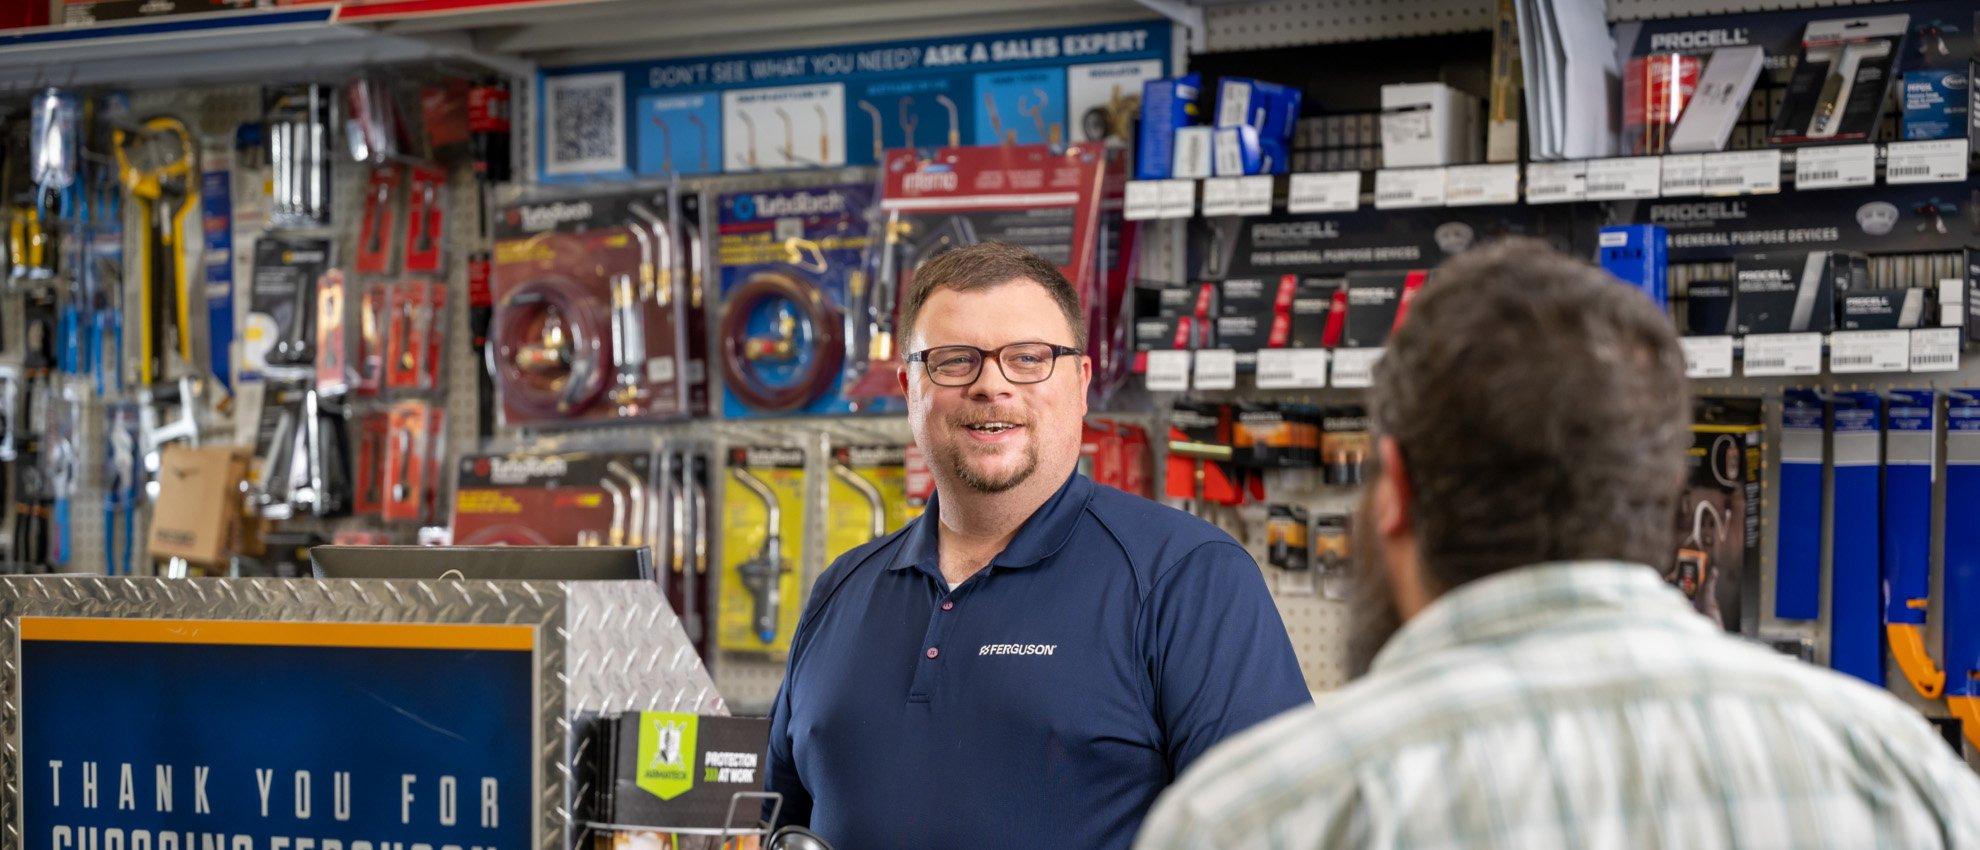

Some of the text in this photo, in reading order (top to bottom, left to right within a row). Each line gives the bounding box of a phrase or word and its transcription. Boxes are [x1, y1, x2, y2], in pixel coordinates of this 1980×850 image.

[1652, 28, 1745, 50] PROCELL
[649, 30, 1147, 88] DON'T SEE WHAT YOU NEED? ASK A SALES EXPERT
[1652, 202, 1746, 221] PROCELL
[1251, 221, 1339, 239] PROCELL
[1676, 232, 1729, 247] GENERAL
[1731, 229, 1786, 244] PURPOSE
[1788, 228, 1839, 241] DEVICES
[990, 643, 1054, 656] FERGUSON
[705, 751, 758, 767] PROTECTION
[718, 768, 756, 783] AT WORK
[49, 760, 499, 828] THANK YOU FOR
